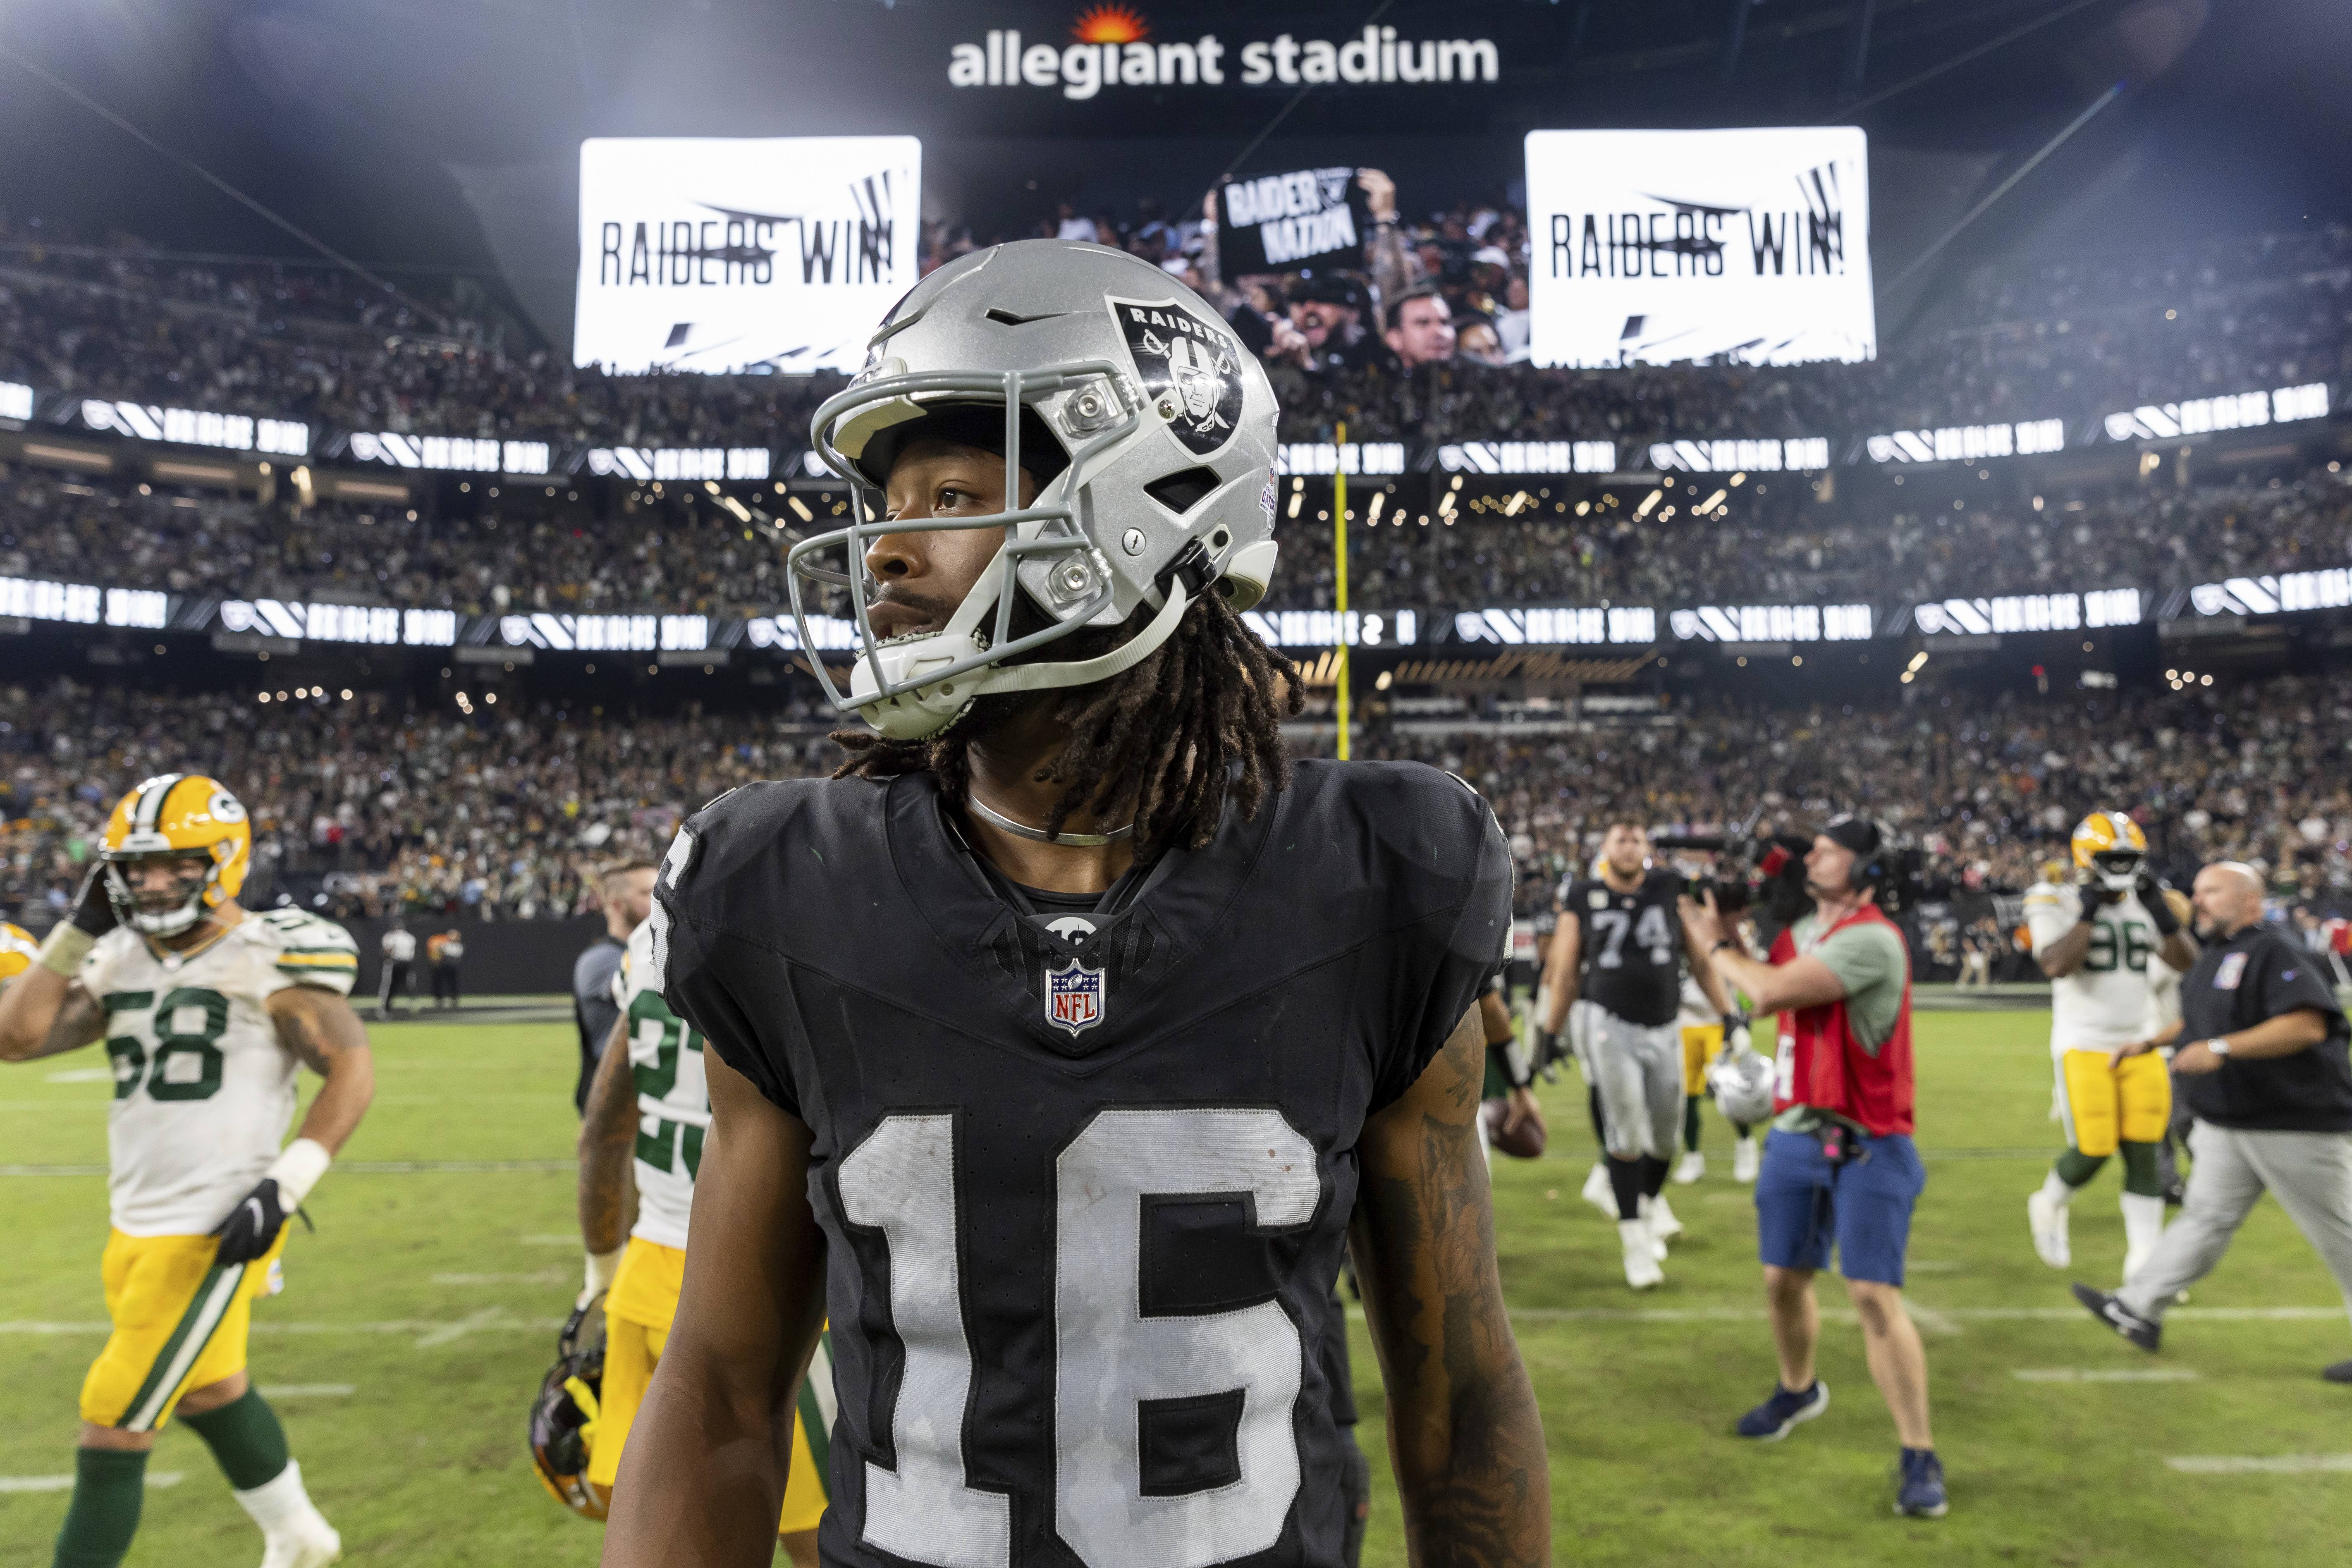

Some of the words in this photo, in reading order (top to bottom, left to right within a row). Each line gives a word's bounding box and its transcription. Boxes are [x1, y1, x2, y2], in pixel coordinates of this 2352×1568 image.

[948, 29, 1224, 99] allegiant
[1241, 25, 1499, 84] stadium
[601, 220, 774, 286] RAIDERS
[1551, 212, 1725, 278] RAIDERS
[1130, 308, 1228, 349] RAIDERS
[1262, 490, 1275, 513] CATCH
[1591, 908, 1673, 969] 74
[1055, 994, 1095, 1022] NFL
[103, 987, 229, 1102] 58
[839, 1109, 1320, 1568] 16
